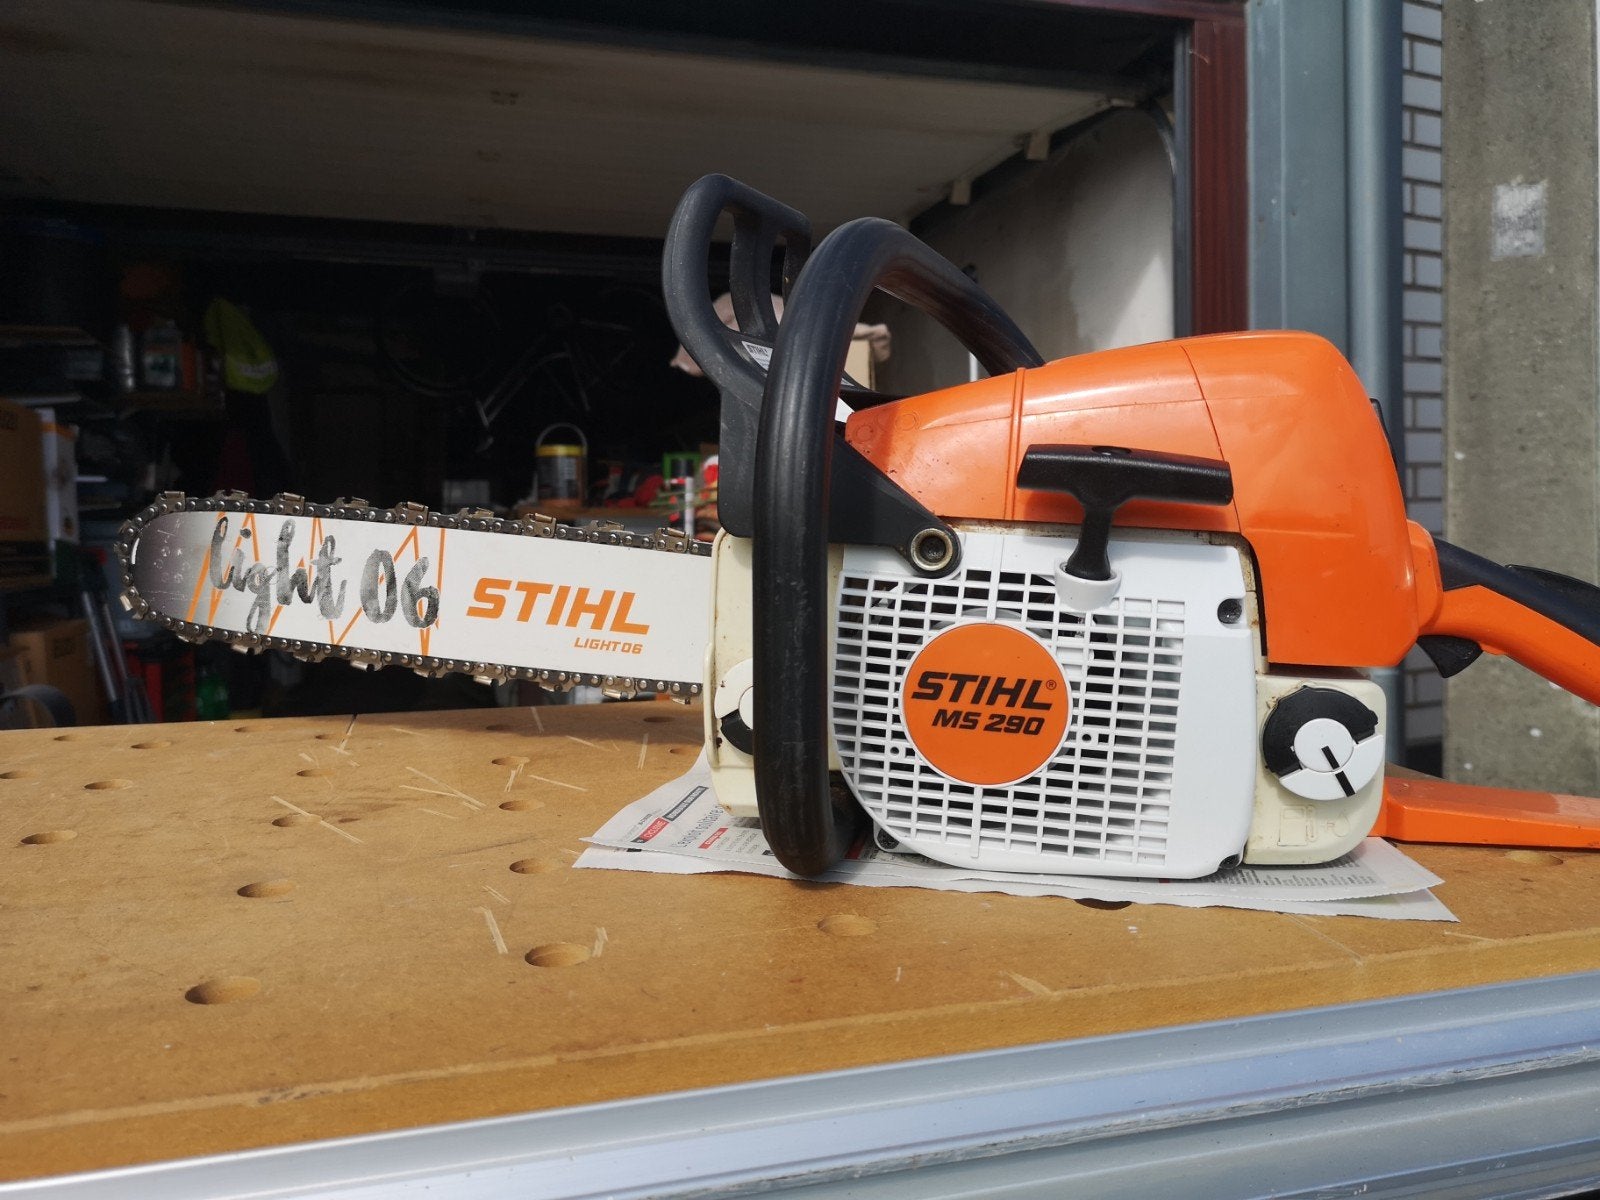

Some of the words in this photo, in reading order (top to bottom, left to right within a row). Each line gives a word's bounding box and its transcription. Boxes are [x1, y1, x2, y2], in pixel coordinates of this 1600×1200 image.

[206, 516, 346, 634] light
[360, 549, 440, 629] 06
[466, 576, 650, 635] STIHL
[911, 671, 1053, 711] STIHL
[931, 708, 982, 730] MS
[983, 713, 1045, 736] 290
